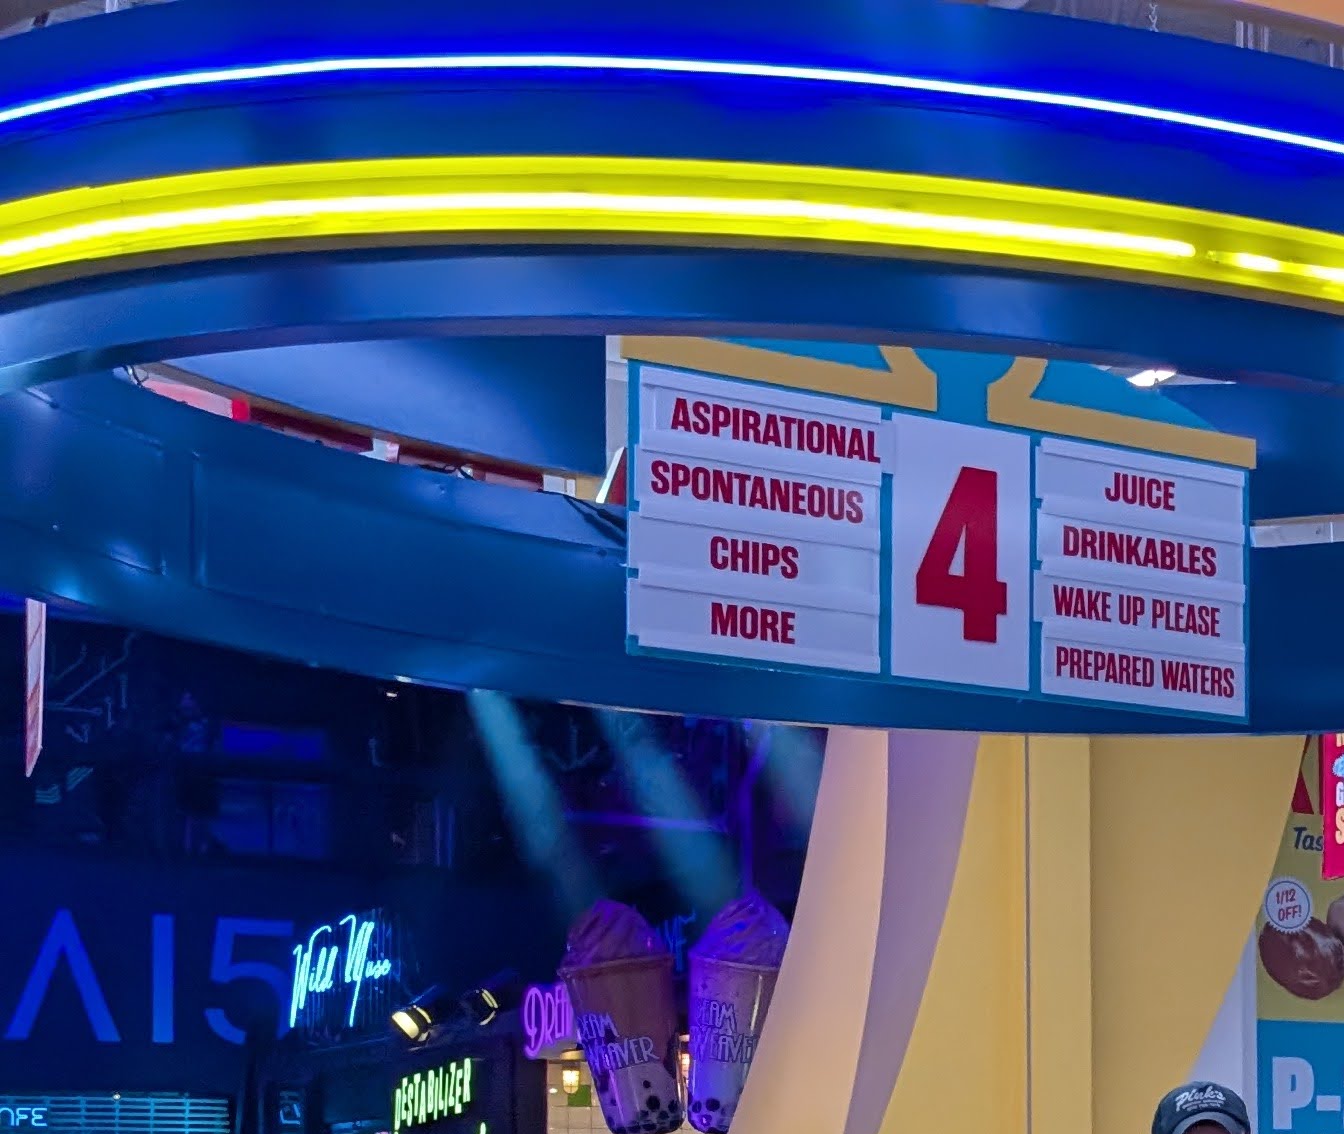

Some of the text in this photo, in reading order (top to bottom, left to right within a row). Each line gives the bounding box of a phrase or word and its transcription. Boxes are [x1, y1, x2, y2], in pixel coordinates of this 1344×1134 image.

[671, 397, 881, 463] ASPIRATIONAL
[650, 460, 864, 523] SPONTANEOUS
[1105, 472, 1176, 512] JUICE
[709, 536, 799, 580] CHIPS
[916, 466, 1008, 643] 4
[1063, 525, 1217, 577] DRINKABLES
[711, 602, 796, 645] MORE
[1054, 584, 1221, 638] WAKE UP PLEASE
[1055, 646, 1235, 699] PREPARED WATERS
[1275, 889, 1297, 906] 1/12
[1278, 904, 1302, 921] OFF!
[290, 926, 338, 1028] Wild
[394, 1057, 472, 1130] DESTABILIZER
